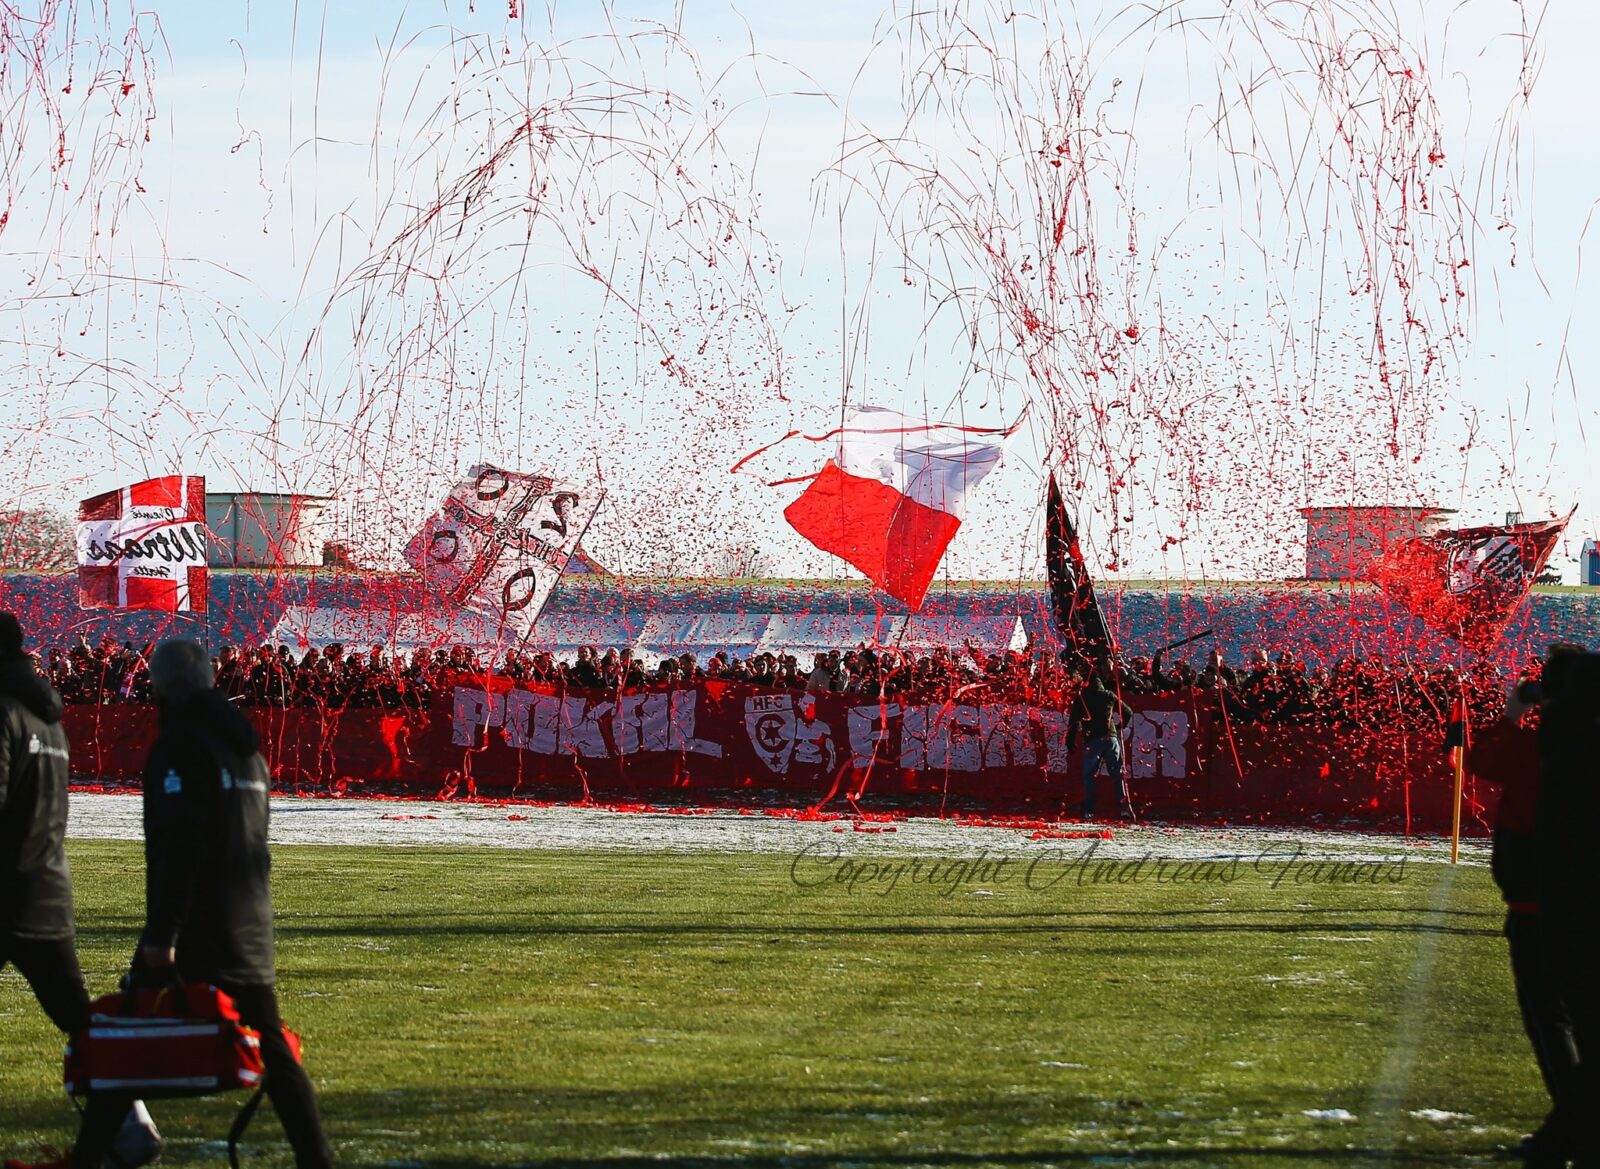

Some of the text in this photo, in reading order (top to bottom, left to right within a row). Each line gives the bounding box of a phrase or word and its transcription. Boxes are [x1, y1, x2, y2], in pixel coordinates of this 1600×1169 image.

[753, 696, 784, 710] HFC
[452, 687, 1188, 779] POKAL FIGHTR
